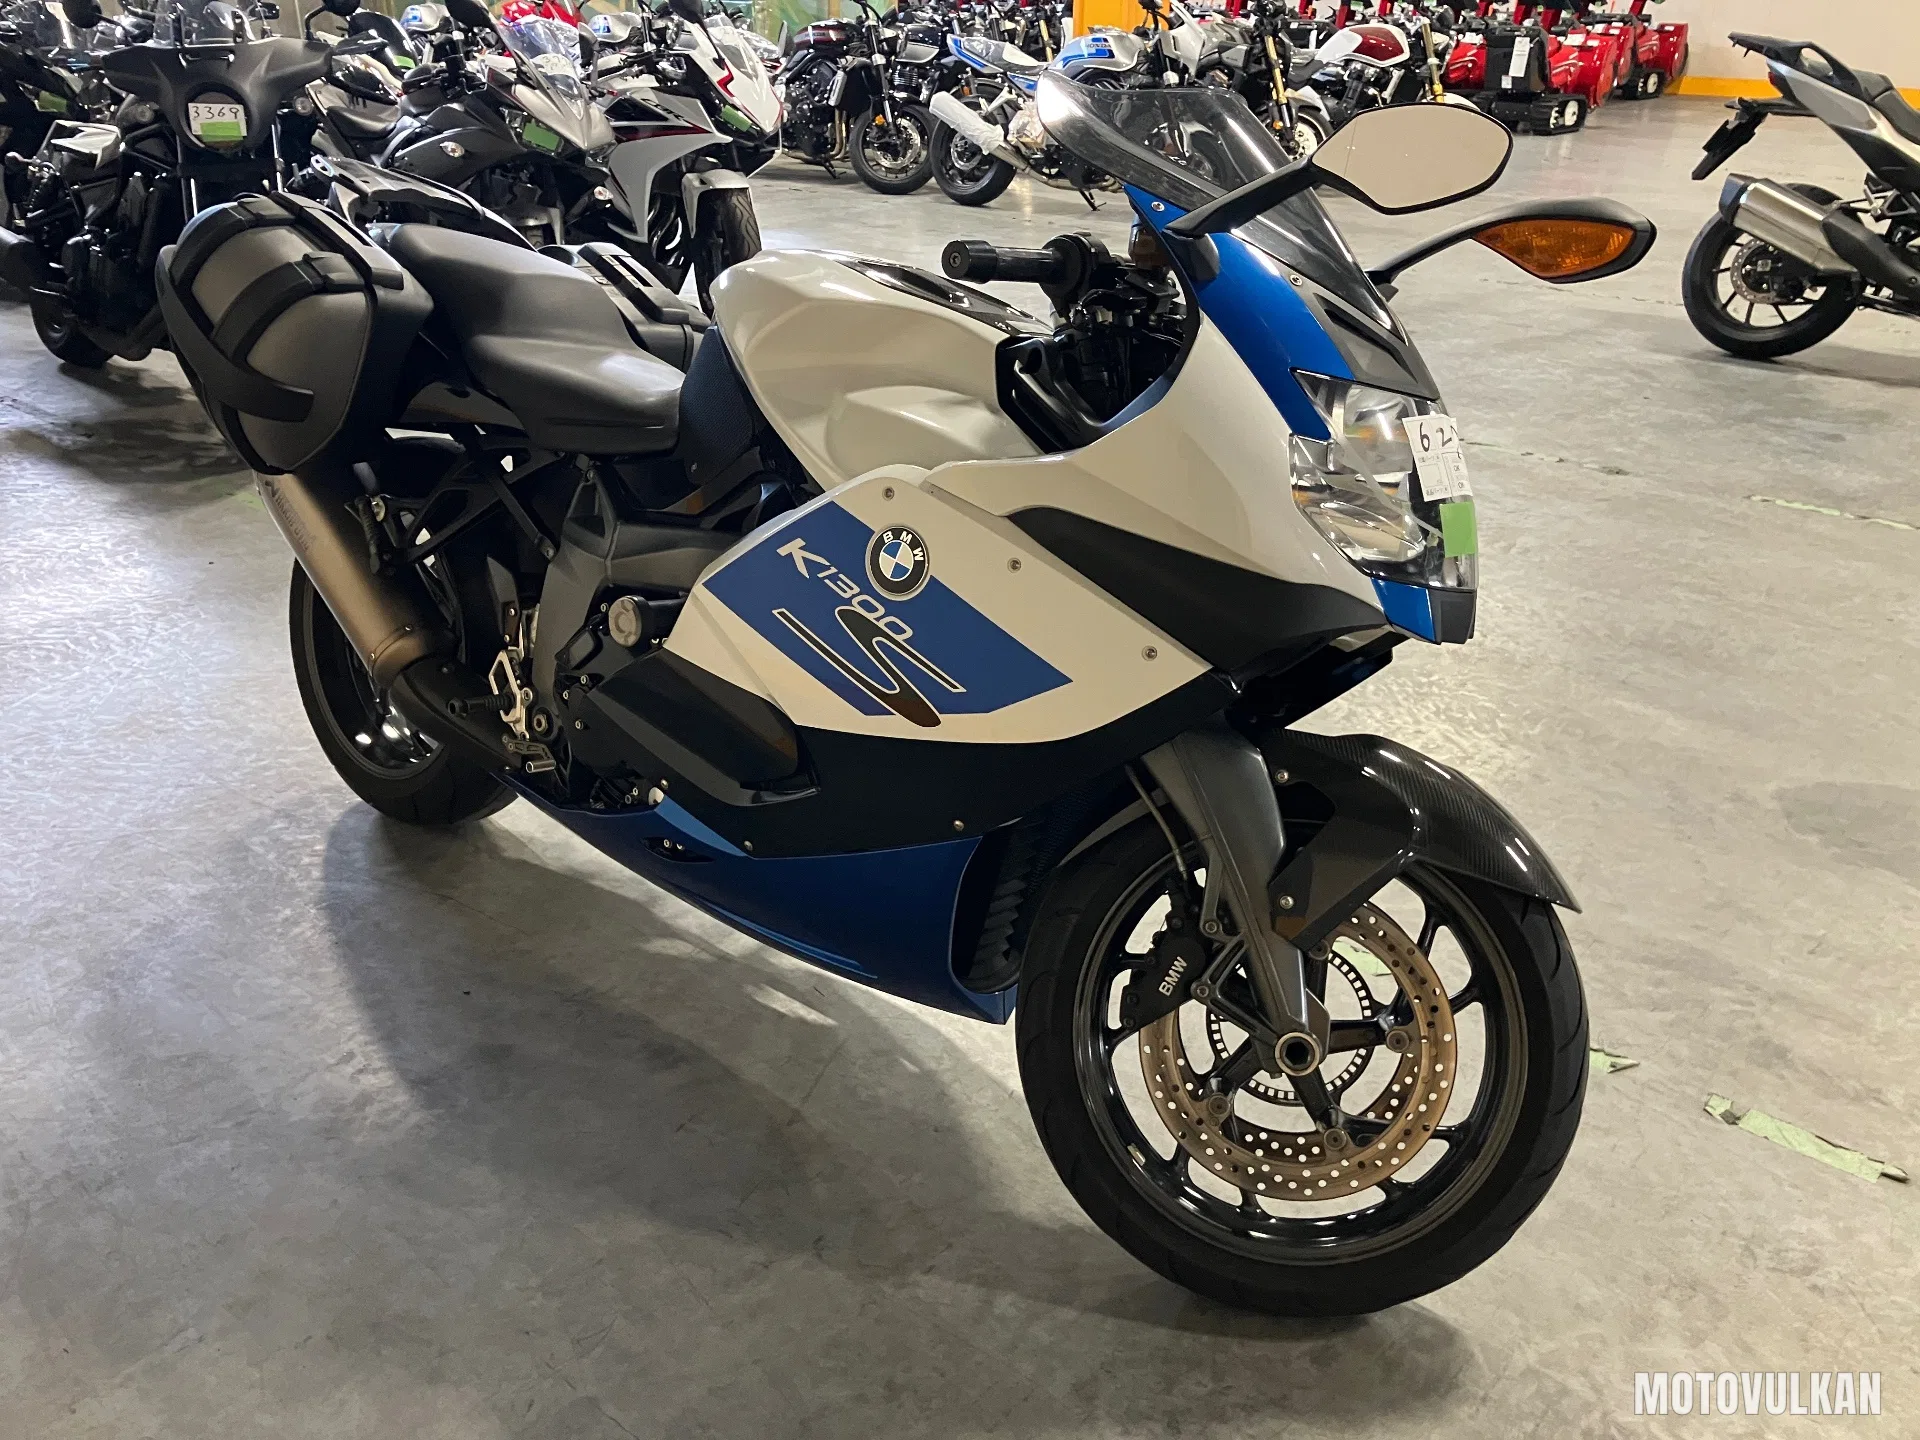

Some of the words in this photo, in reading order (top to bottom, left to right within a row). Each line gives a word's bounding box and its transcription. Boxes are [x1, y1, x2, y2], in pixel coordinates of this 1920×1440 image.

[191, 106, 240, 119] 3369
[882, 530, 924, 561] BMW
[776, 537, 913, 640] K1300
[1158, 956, 1188, 996] BMW
